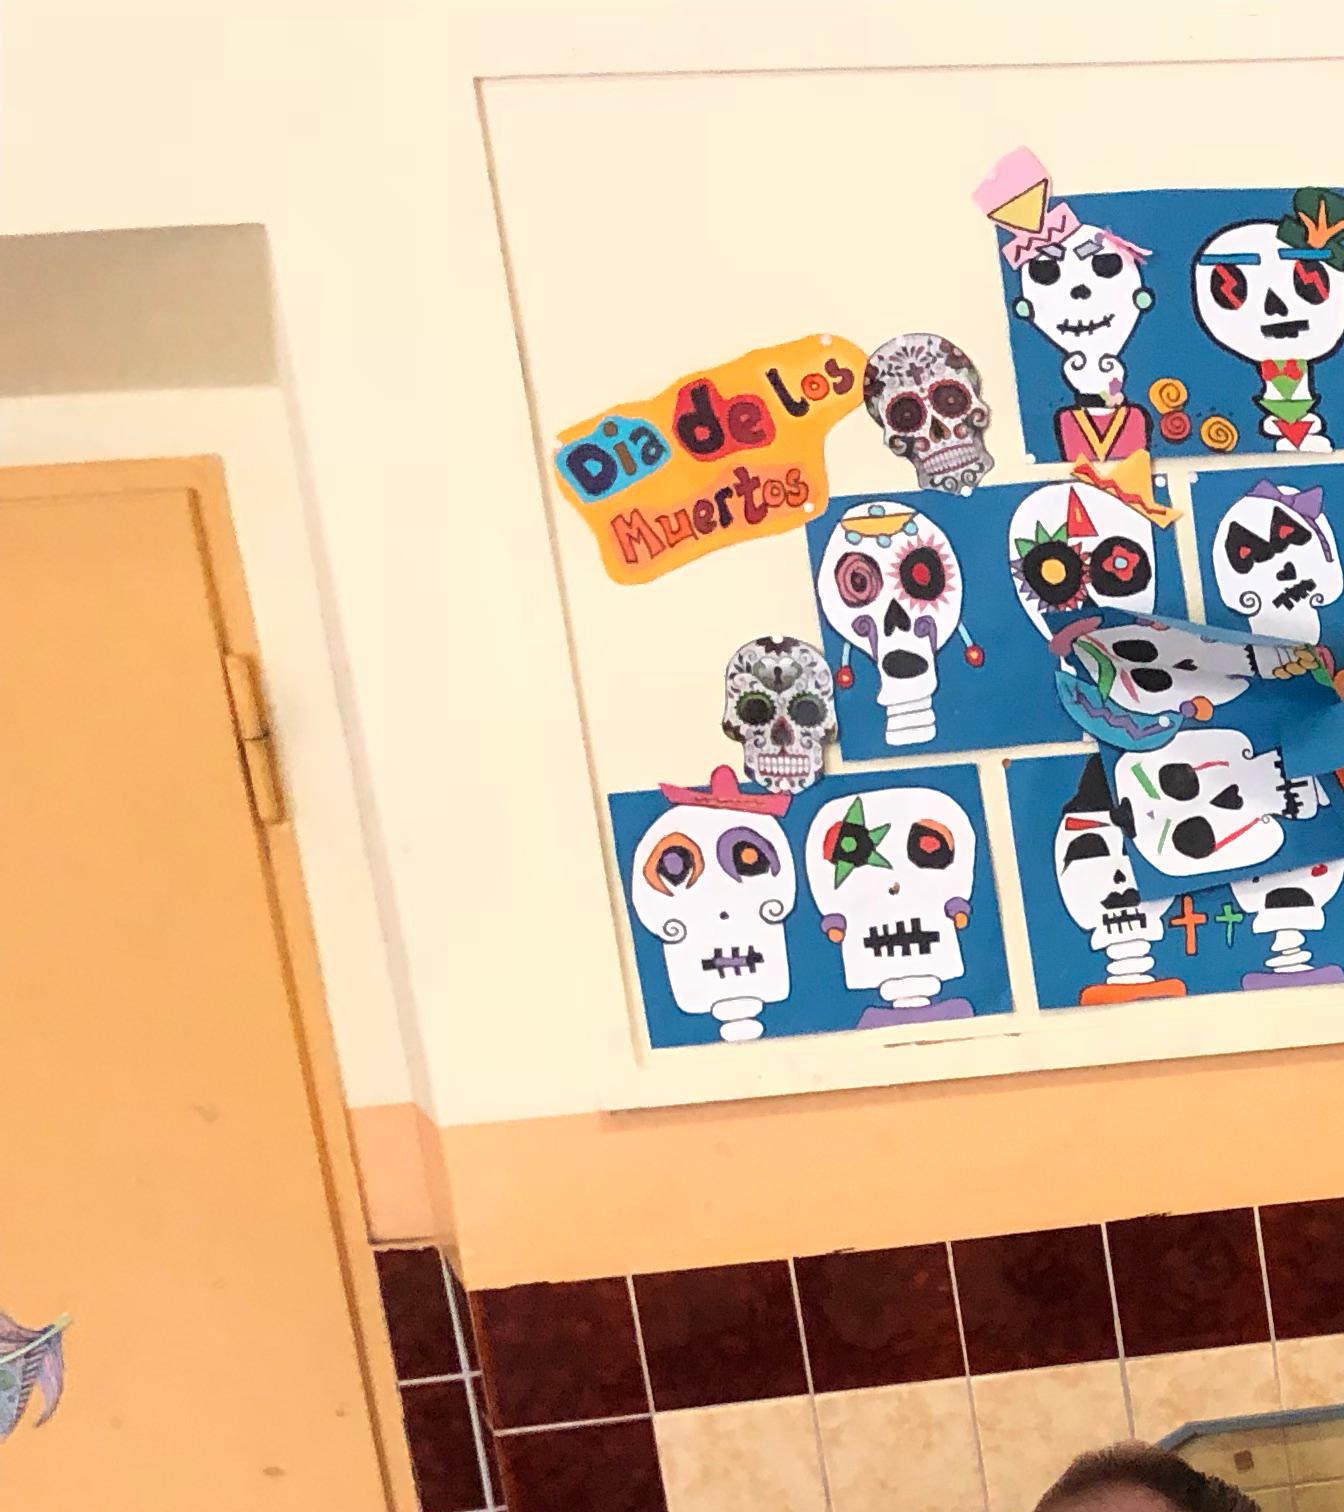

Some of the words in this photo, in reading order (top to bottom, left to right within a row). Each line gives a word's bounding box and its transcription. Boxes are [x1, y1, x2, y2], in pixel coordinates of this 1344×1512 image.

[566, 420, 667, 496] Dia
[677, 384, 768, 456] de
[610, 466, 809, 564] Muertos
